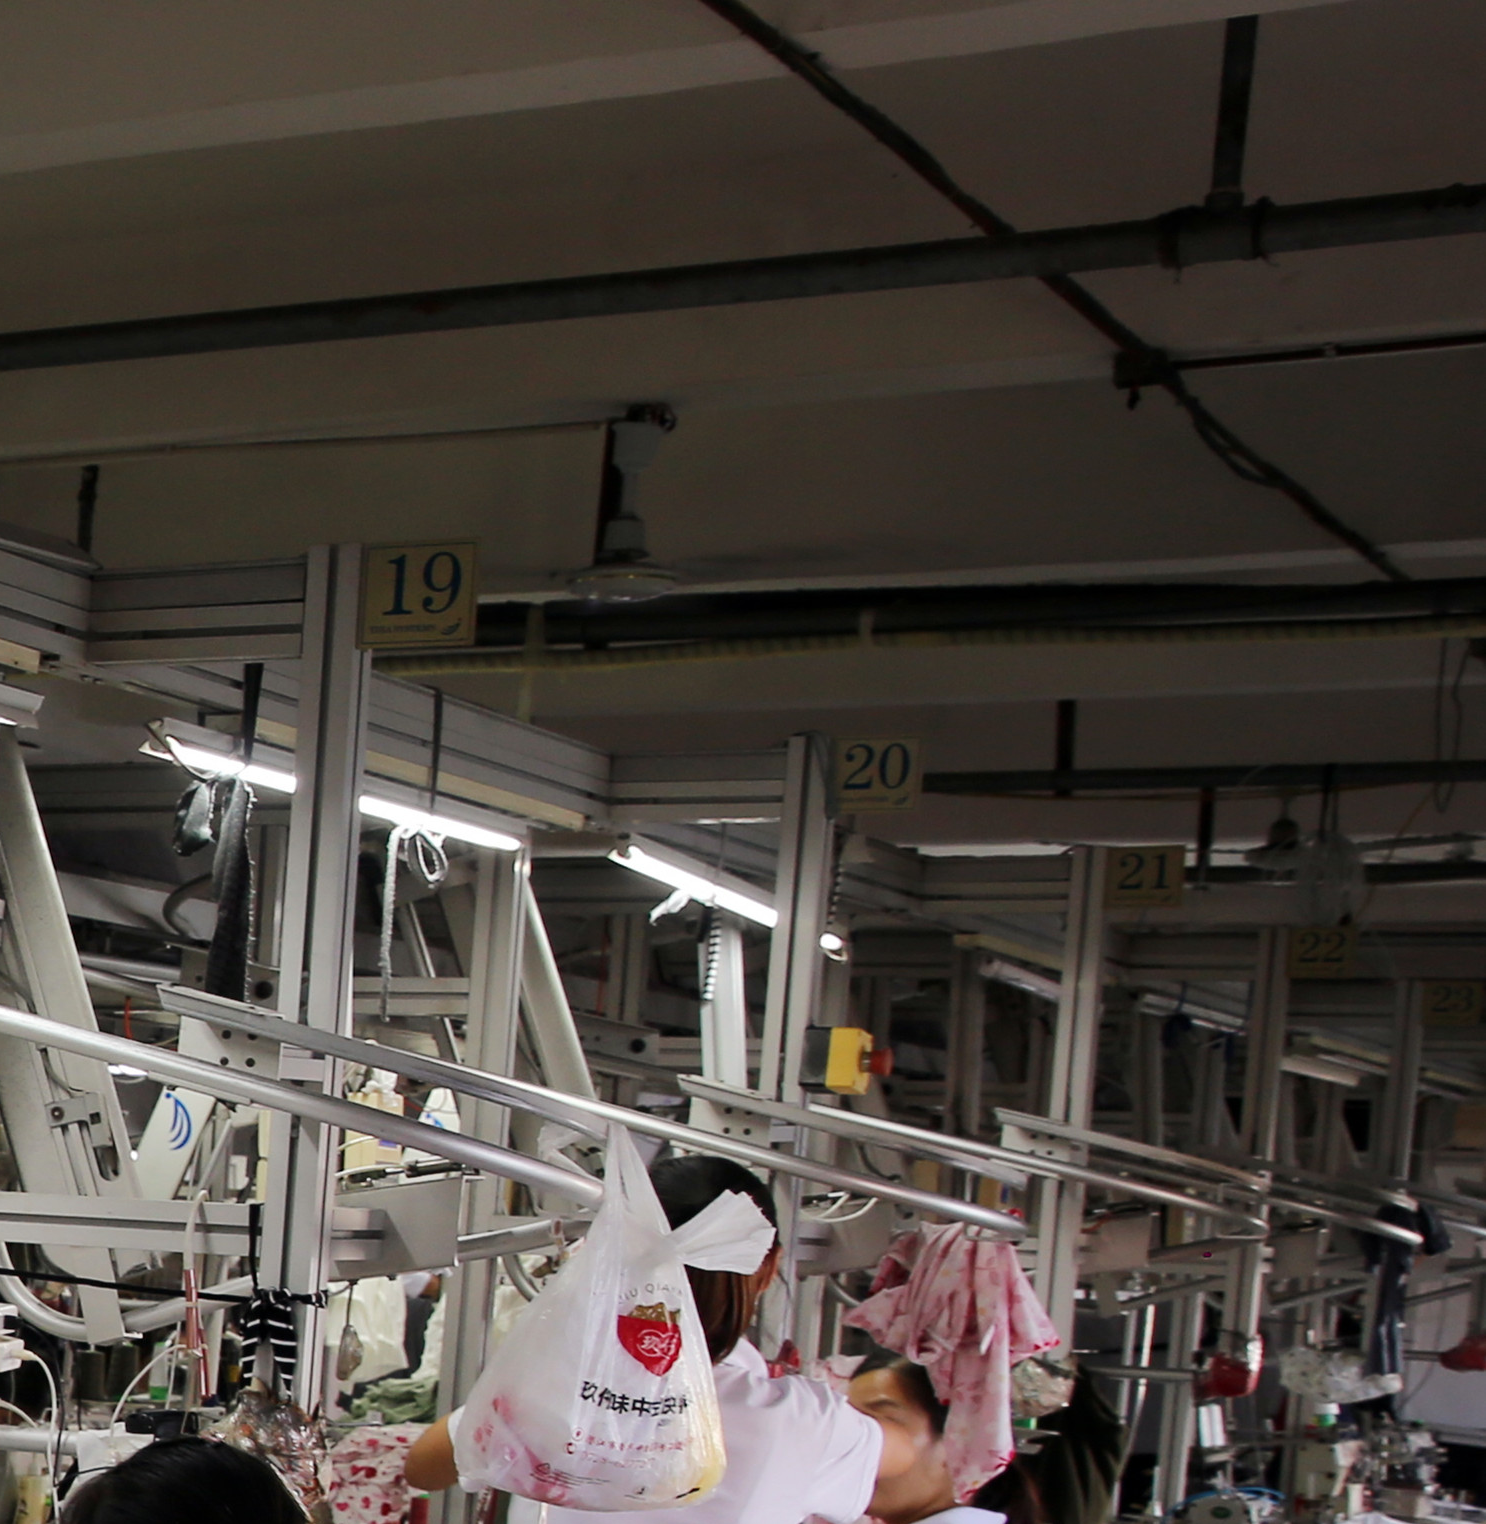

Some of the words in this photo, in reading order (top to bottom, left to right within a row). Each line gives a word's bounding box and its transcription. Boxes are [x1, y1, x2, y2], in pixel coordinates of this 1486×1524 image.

[381, 551, 462, 616] 19
[842, 743, 910, 791] 20
[1116, 852, 1170, 890] 21
[1298, 930, 1346, 963] 22
[1431, 984, 1474, 1014] 23
